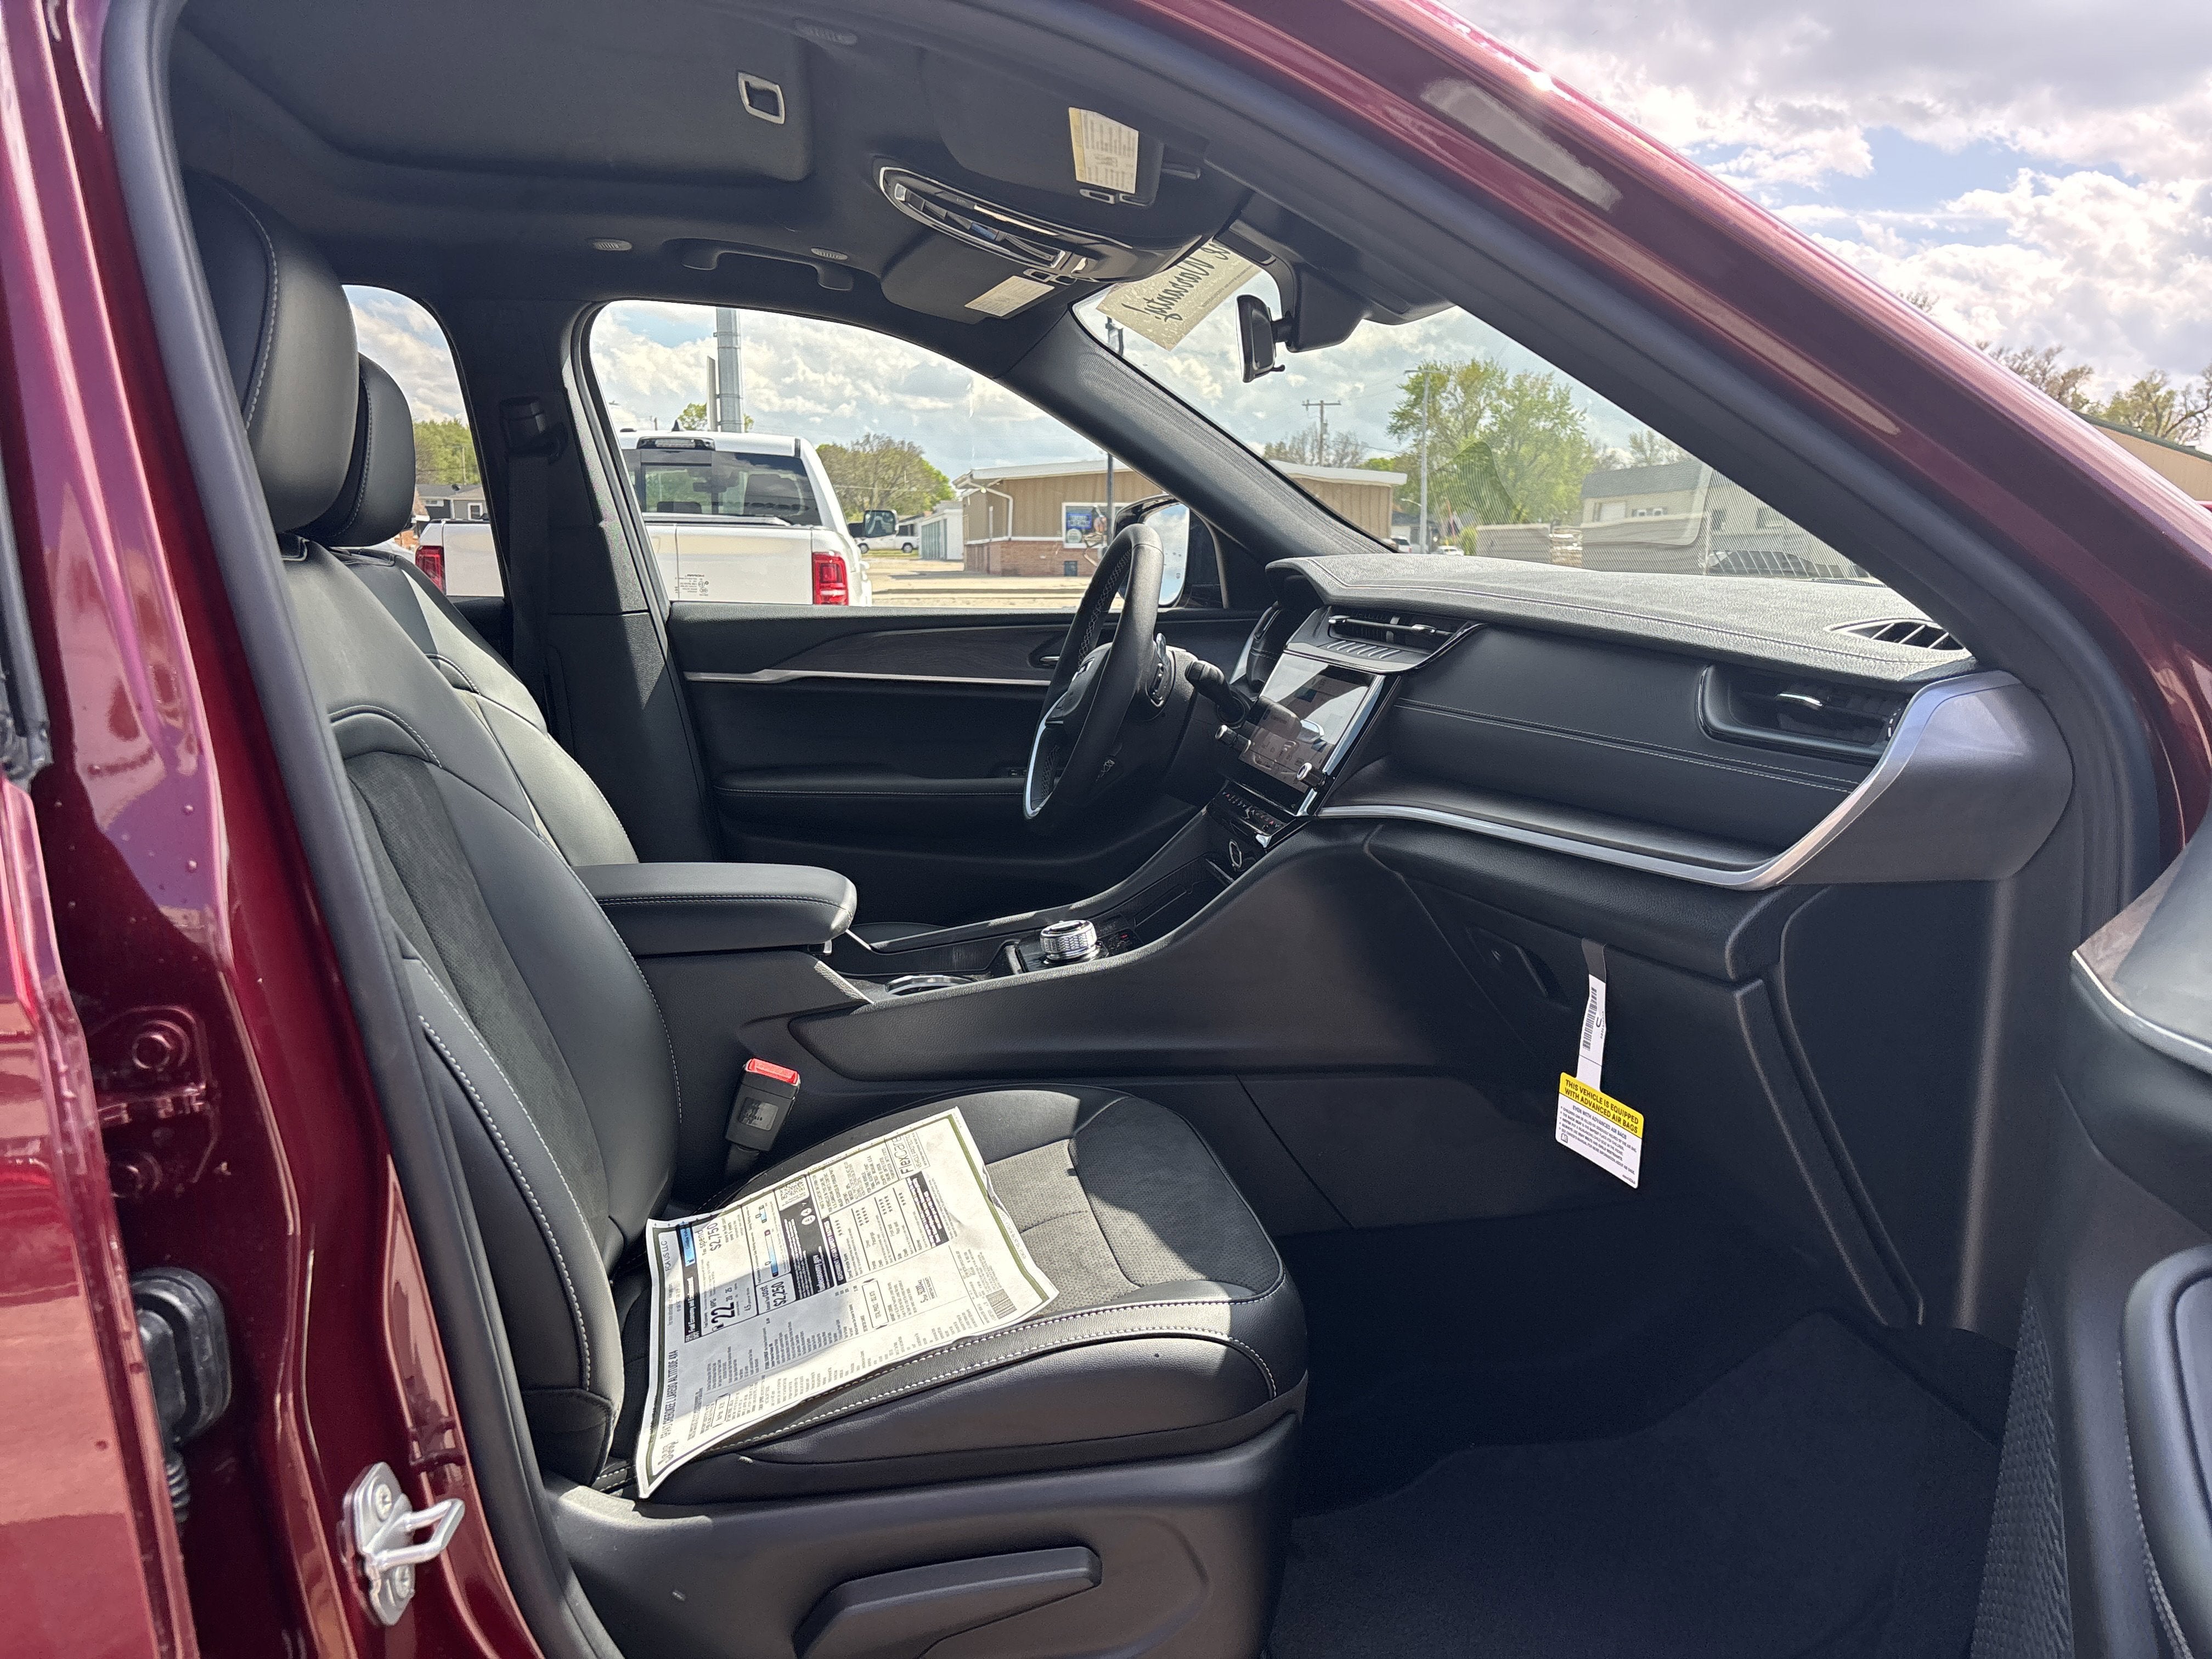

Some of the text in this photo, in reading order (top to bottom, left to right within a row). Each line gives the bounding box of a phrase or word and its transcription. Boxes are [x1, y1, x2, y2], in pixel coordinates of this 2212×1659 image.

[1565, 1087, 1638, 1133] WITH ADVANCED AIR BAGS
[1566, 1079, 1638, 1125] THIS VEHICLE IS EQUIPPED
[1573, 1105, 1581, 1114] EVEN
[1583, 1110, 1591, 1119] WITH
[1592, 1116, 1610, 1130] ADVANCED
[1617, 1130, 1626, 1139] BAGS
[891, 1136, 913, 1173] FlexCare
[912, 1154, 922, 1168] VEHICLE
[695, 1229, 707, 1248] spend
[707, 1222, 722, 1251] $2,750
[662, 1252, 670, 1261] US
[812, 1254, 825, 1292] fueleconomy.gov
[834, 1259, 843, 1280] GOVERNMENT
[760, 1285, 769, 1297] cost
[770, 1279, 788, 1307] $2,250
[688, 1306, 696, 1324] Economy
[710, 1301, 735, 1326] 22
[669, 1349, 678, 1361] 4X4
[668, 1358, 677, 1384] ALTITUDE
[667, 1381, 677, 1401] LAREDO
[663, 1401, 675, 1425] CHEROKEE
[657, 1440, 678, 1466] Jeep
